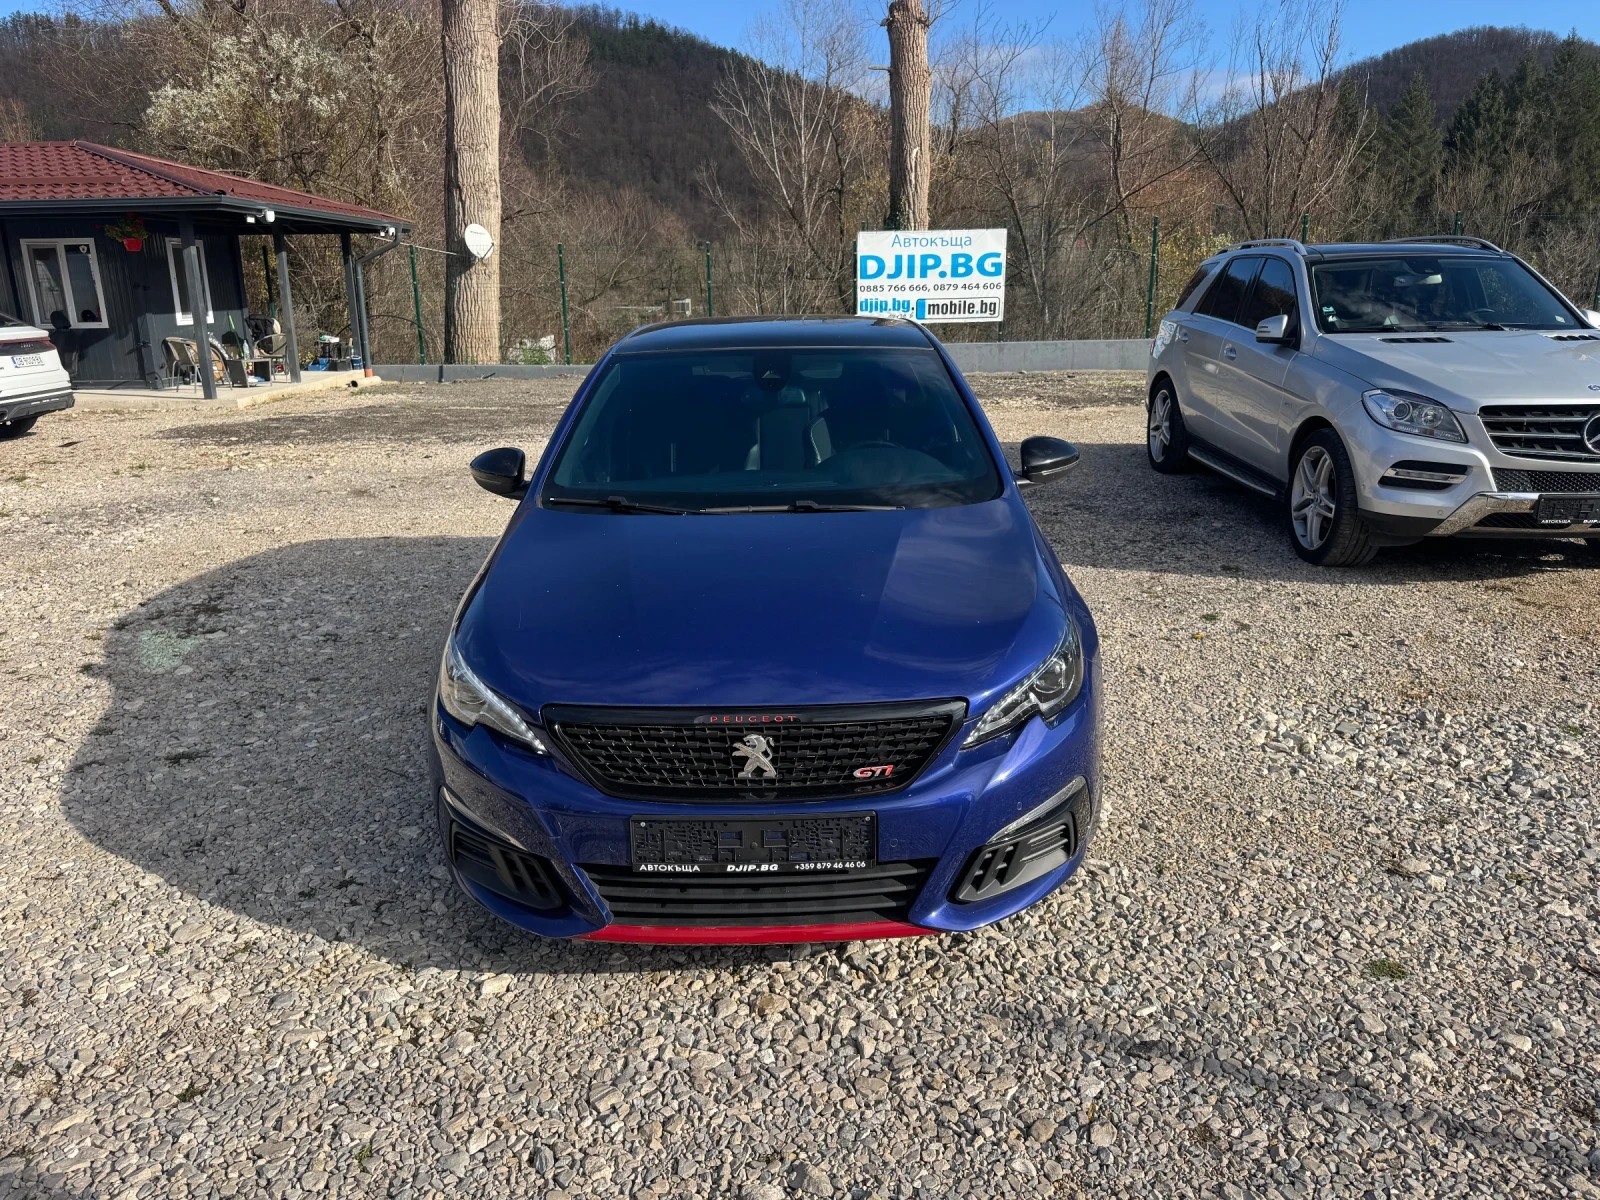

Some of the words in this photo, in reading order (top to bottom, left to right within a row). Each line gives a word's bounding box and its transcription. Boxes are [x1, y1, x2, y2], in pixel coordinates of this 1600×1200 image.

[891, 234, 972, 249] Автокъща
[859, 252, 1003, 280] DJIP.BG
[859, 285, 885, 293] 0885
[887, 284, 906, 292] 766
[908, 284, 931, 293] 666,
[933, 283, 958, 291] 0879
[961, 283, 980, 291] 464
[982, 282, 1002, 290] 606
[927, 299, 997, 316] mobile.bg
[710, 715, 797, 723] PEUGEOT
[639, 864, 701, 872] АВТОКЪЩА
[726, 863, 779, 872] DJIP.BG
[794, 862, 815, 870] +359
[815, 862, 832, 870] 879
[832, 861, 843, 869] 46
[844, 861, 855, 869] 46
